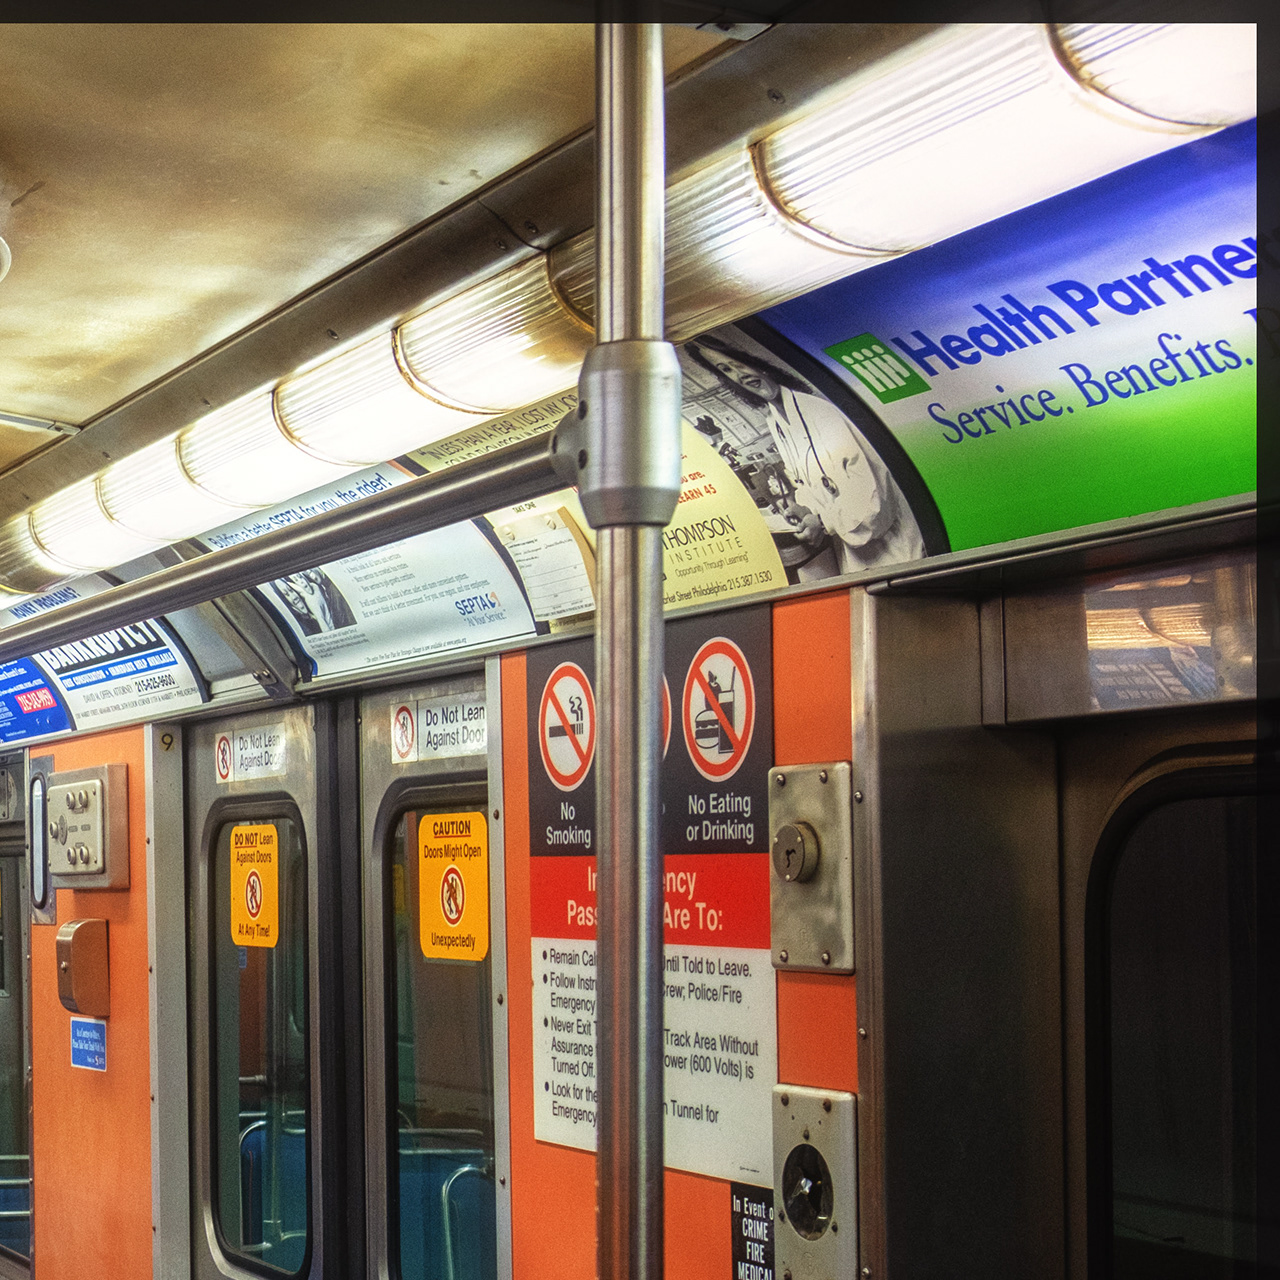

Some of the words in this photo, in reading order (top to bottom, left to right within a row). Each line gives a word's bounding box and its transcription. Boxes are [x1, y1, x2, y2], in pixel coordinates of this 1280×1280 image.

[891, 293, 1058, 377] Health
[927, 383, 1075, 444] Service.
[1059, 330, 1255, 412] Benefits.
[439, 441, 461, 457] LESS
[458, 432, 485, 449] THAN
[519, 407, 548, 425] LOST
[543, 400, 564, 418] MY
[356, 472, 393, 498] rider!
[704, 483, 718, 496] 45
[512, 506, 526, 514] TAKE
[525, 502, 537, 511] ONE
[662, 514, 737, 551] THOMPSON
[668, 536, 744, 566] INSTITUTE
[675, 562, 705, 578] Opportunity
[703, 557, 725, 574] Through
[675, 590, 693, 604] Street
[691, 578, 728, 600] Philadelphia
[726, 569, 774, 592] 215.387.1530
[8, 600, 38, 620] MONEY
[37, 585, 82, 610] PROBLEMS?
[455, 594, 489, 616] SEPTA
[40, 619, 158, 670] BANKRUPTCY
[134, 673, 177, 693] 215-625-9600
[426, 711, 440, 727] Do
[441, 707, 460, 725] Not
[462, 705, 486, 722] Lean
[160, 732, 174, 751] 9
[239, 735, 250, 751] Do
[250, 733, 264, 750] Not
[426, 730, 461, 751] Against
[240, 751, 264, 772] Against
[560, 800, 576, 823] No
[688, 794, 707, 816] No
[708, 792, 753, 818] Eating
[234, 833, 244, 847] DO
[244, 832, 258, 846] NOT
[259, 832, 274, 846] Lean
[432, 820, 471, 836] CAUTION
[545, 824, 592, 850] Smoking
[686, 823, 700, 843] or
[701, 819, 756, 846] Drinking
[236, 850, 256, 865] Against
[256, 850, 273, 864] Doors
[424, 845, 444, 860] Doors
[443, 844, 464, 862] Might
[463, 844, 483, 861] Open
[663, 902, 691, 930] Are
[695, 902, 724, 932] To:
[238, 924, 246, 936] At
[245, 924, 257, 940] Any
[256, 923, 271, 938] Time!
[430, 932, 477, 951] Unexpectedly
[549, 947, 581, 966] Remain
[682, 955, 703, 975] Told
[705, 957, 715, 975] to
[718, 957, 753, 978] Leave.
[550, 972, 576, 990] Follow
[551, 992, 596, 1015] Emergency
[688, 982, 743, 1004] Police/Fire
[550, 1016, 575, 1034] Never
[576, 1018, 592, 1036] Exit
[551, 1036, 594, 1057] Assurance
[664, 1028, 691, 1048] Track
[694, 1031, 717, 1051] Area
[720, 1034, 759, 1057] Without
[551, 1056, 579, 1077] Turned
[581, 1059, 596, 1079] Off.
[690, 1054, 712, 1075] (600
[713, 1060, 743, 1081] Volts)
[745, 1062, 755, 1080] is
[551, 1080, 572, 1099] Look
[573, 1083, 585, 1101] for
[586, 1085, 598, 1103] the
[552, 1102, 598, 1126] Emergency
[670, 1100, 704, 1122] Tunnel
[705, 1105, 720, 1124] for
[733, 1194, 741, 1212] In
[743, 1197, 766, 1220] Event
[742, 1218, 770, 1243] CRIME
[746, 1240, 766, 1265] FIRE
